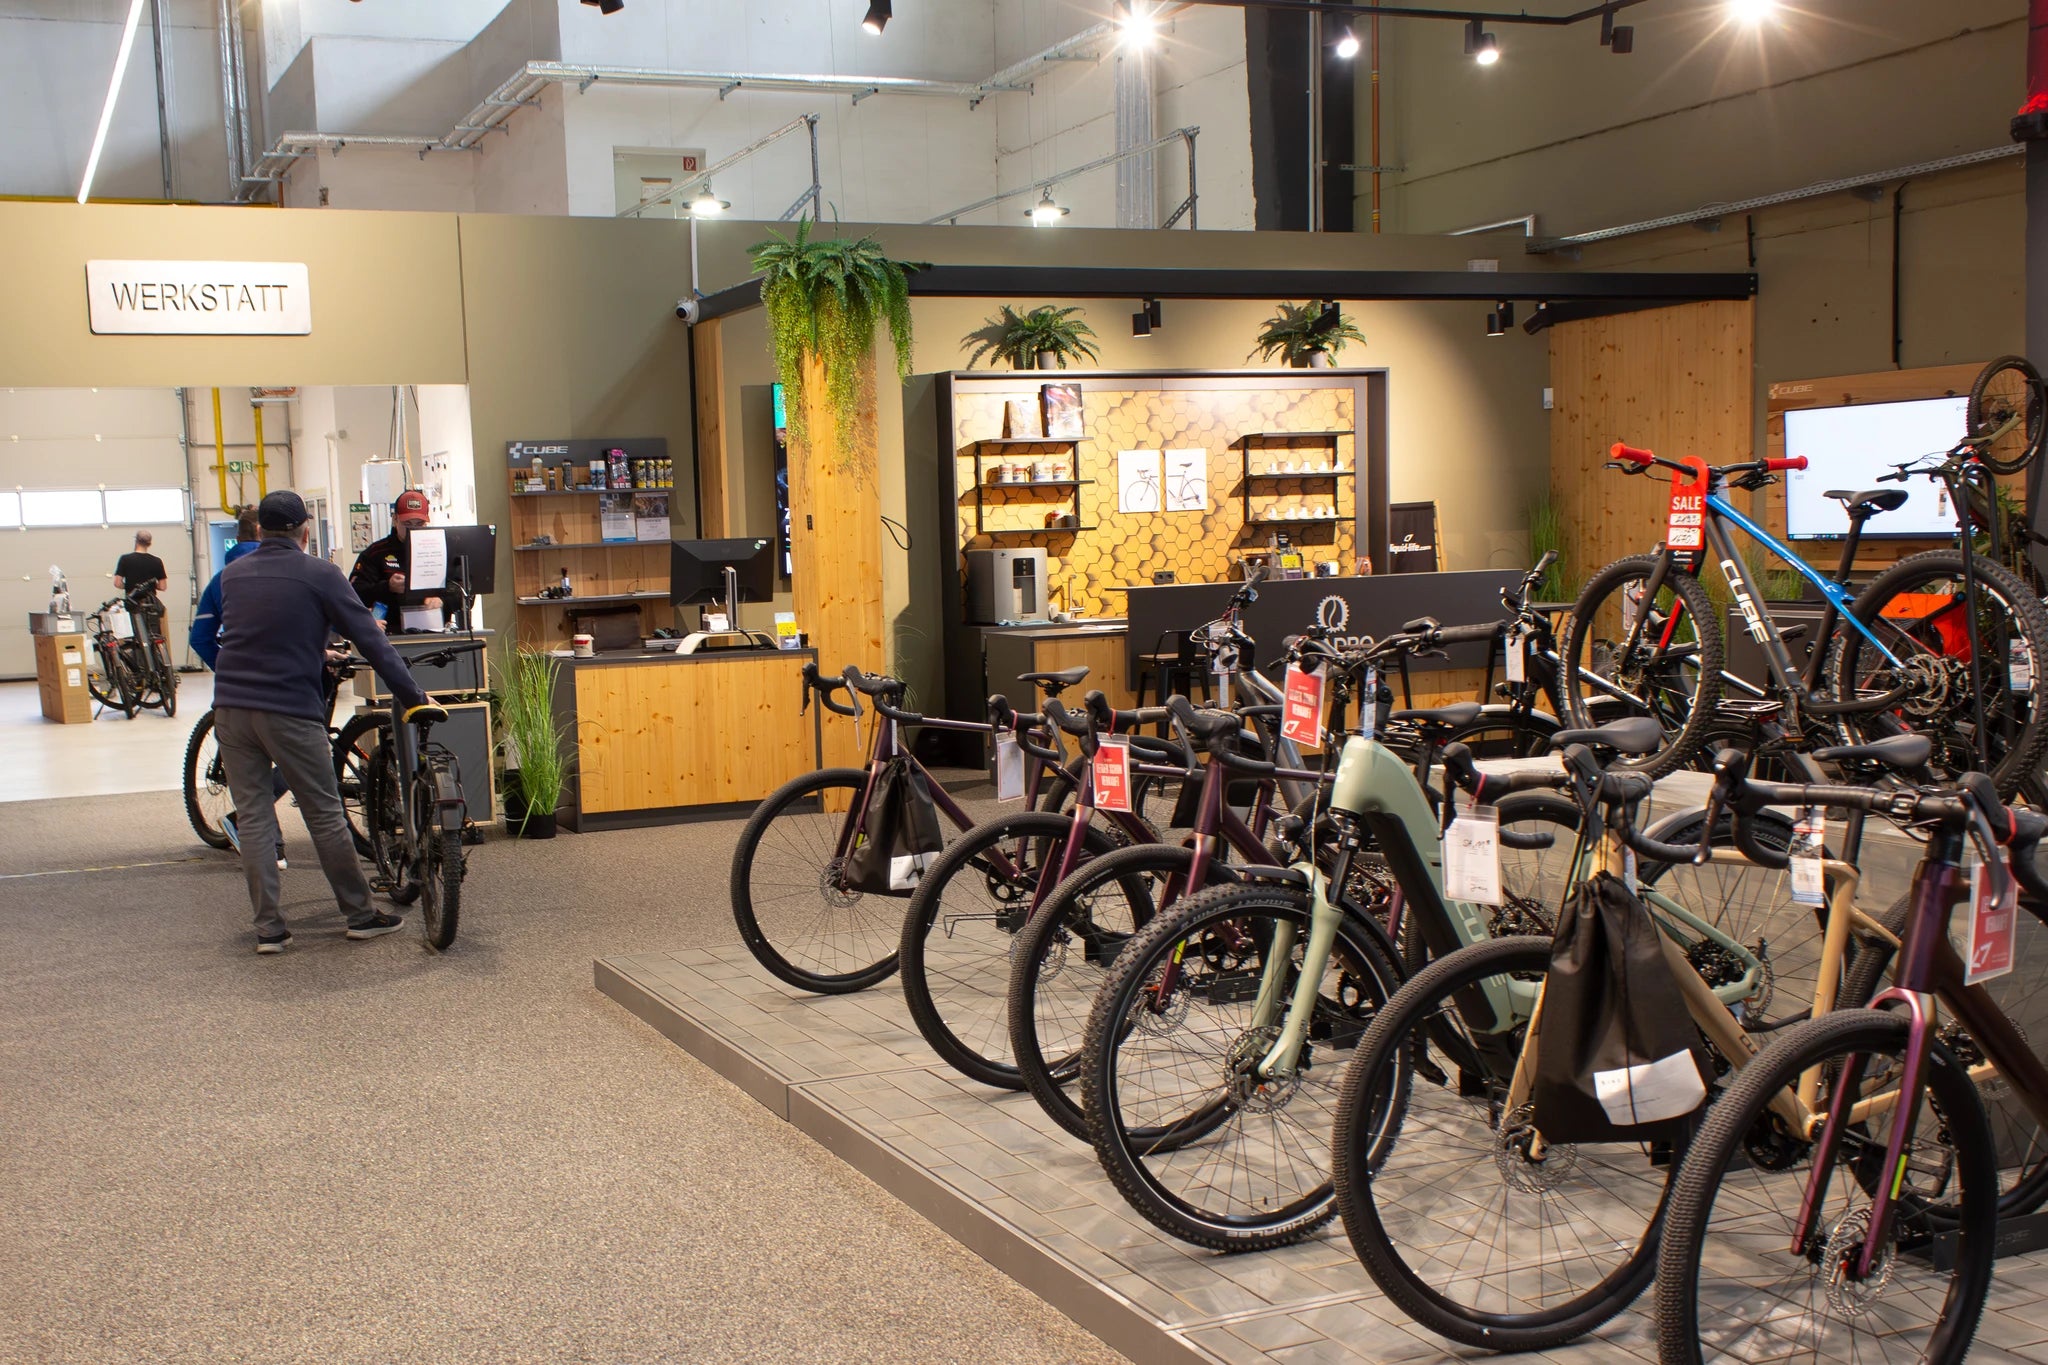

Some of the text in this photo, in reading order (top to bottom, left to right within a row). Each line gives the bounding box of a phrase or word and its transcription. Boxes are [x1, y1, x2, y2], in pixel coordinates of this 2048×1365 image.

[111, 283, 288, 312] WERKSTATT
[1778, 384, 1814, 395] CUBE
[523, 445, 568, 455] CUBE
[1672, 496, 1702, 511] SALE
[1720, 559, 1771, 644] CUBE
[1225, 1205, 1329, 1239] SCHWALBE
